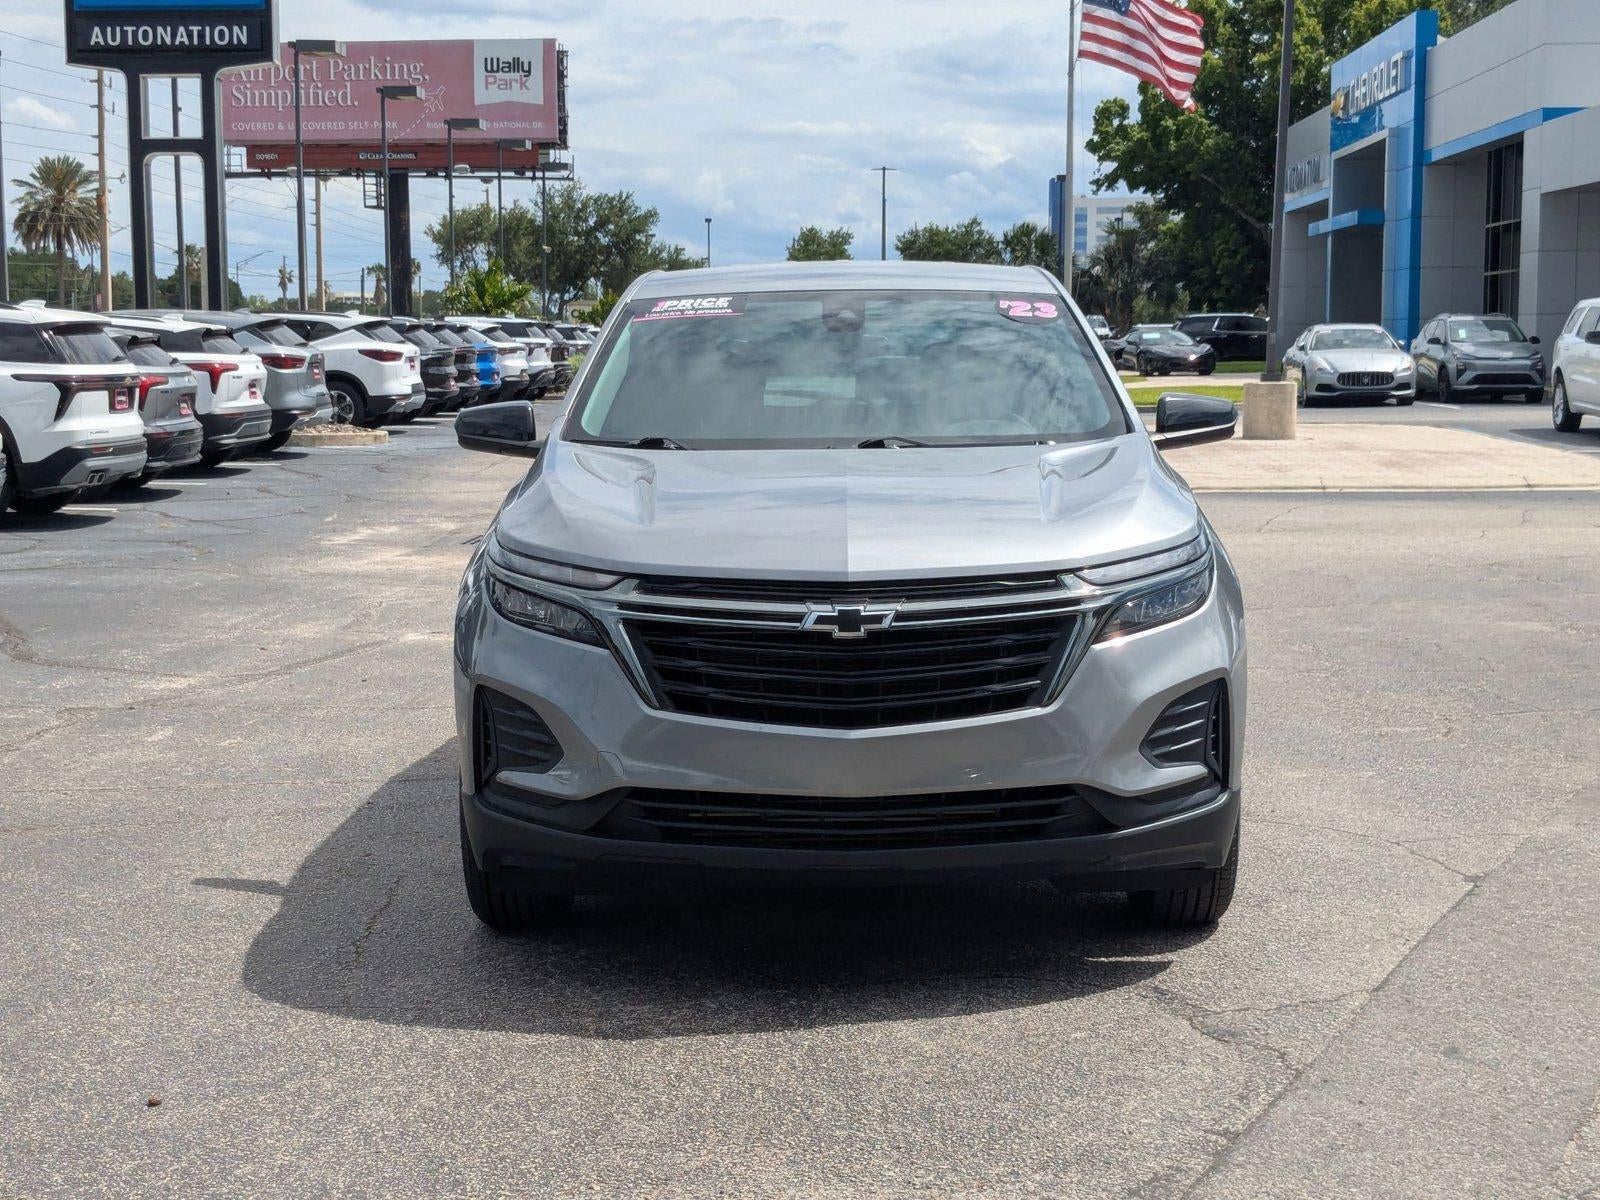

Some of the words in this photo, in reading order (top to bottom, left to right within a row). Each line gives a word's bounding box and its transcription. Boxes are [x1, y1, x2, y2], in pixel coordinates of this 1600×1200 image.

[90, 25, 248, 46] AUTONATION
[328, 56, 430, 85] Parking,
[483, 56, 532, 78] Wally
[484, 74, 531, 91] Park
[1348, 50, 1404, 116] CHEVROLET
[231, 81, 360, 112] Simplified.
[231, 121, 275, 131] COVERED
[277, 122, 284, 131] &
[288, 120, 346, 131] UCOVERED
[493, 121, 531, 129] NATIONAL
[367, 152, 385, 160] CLEA
[387, 152, 417, 160] CHANNEL
[999, 300, 1059, 318] '23
